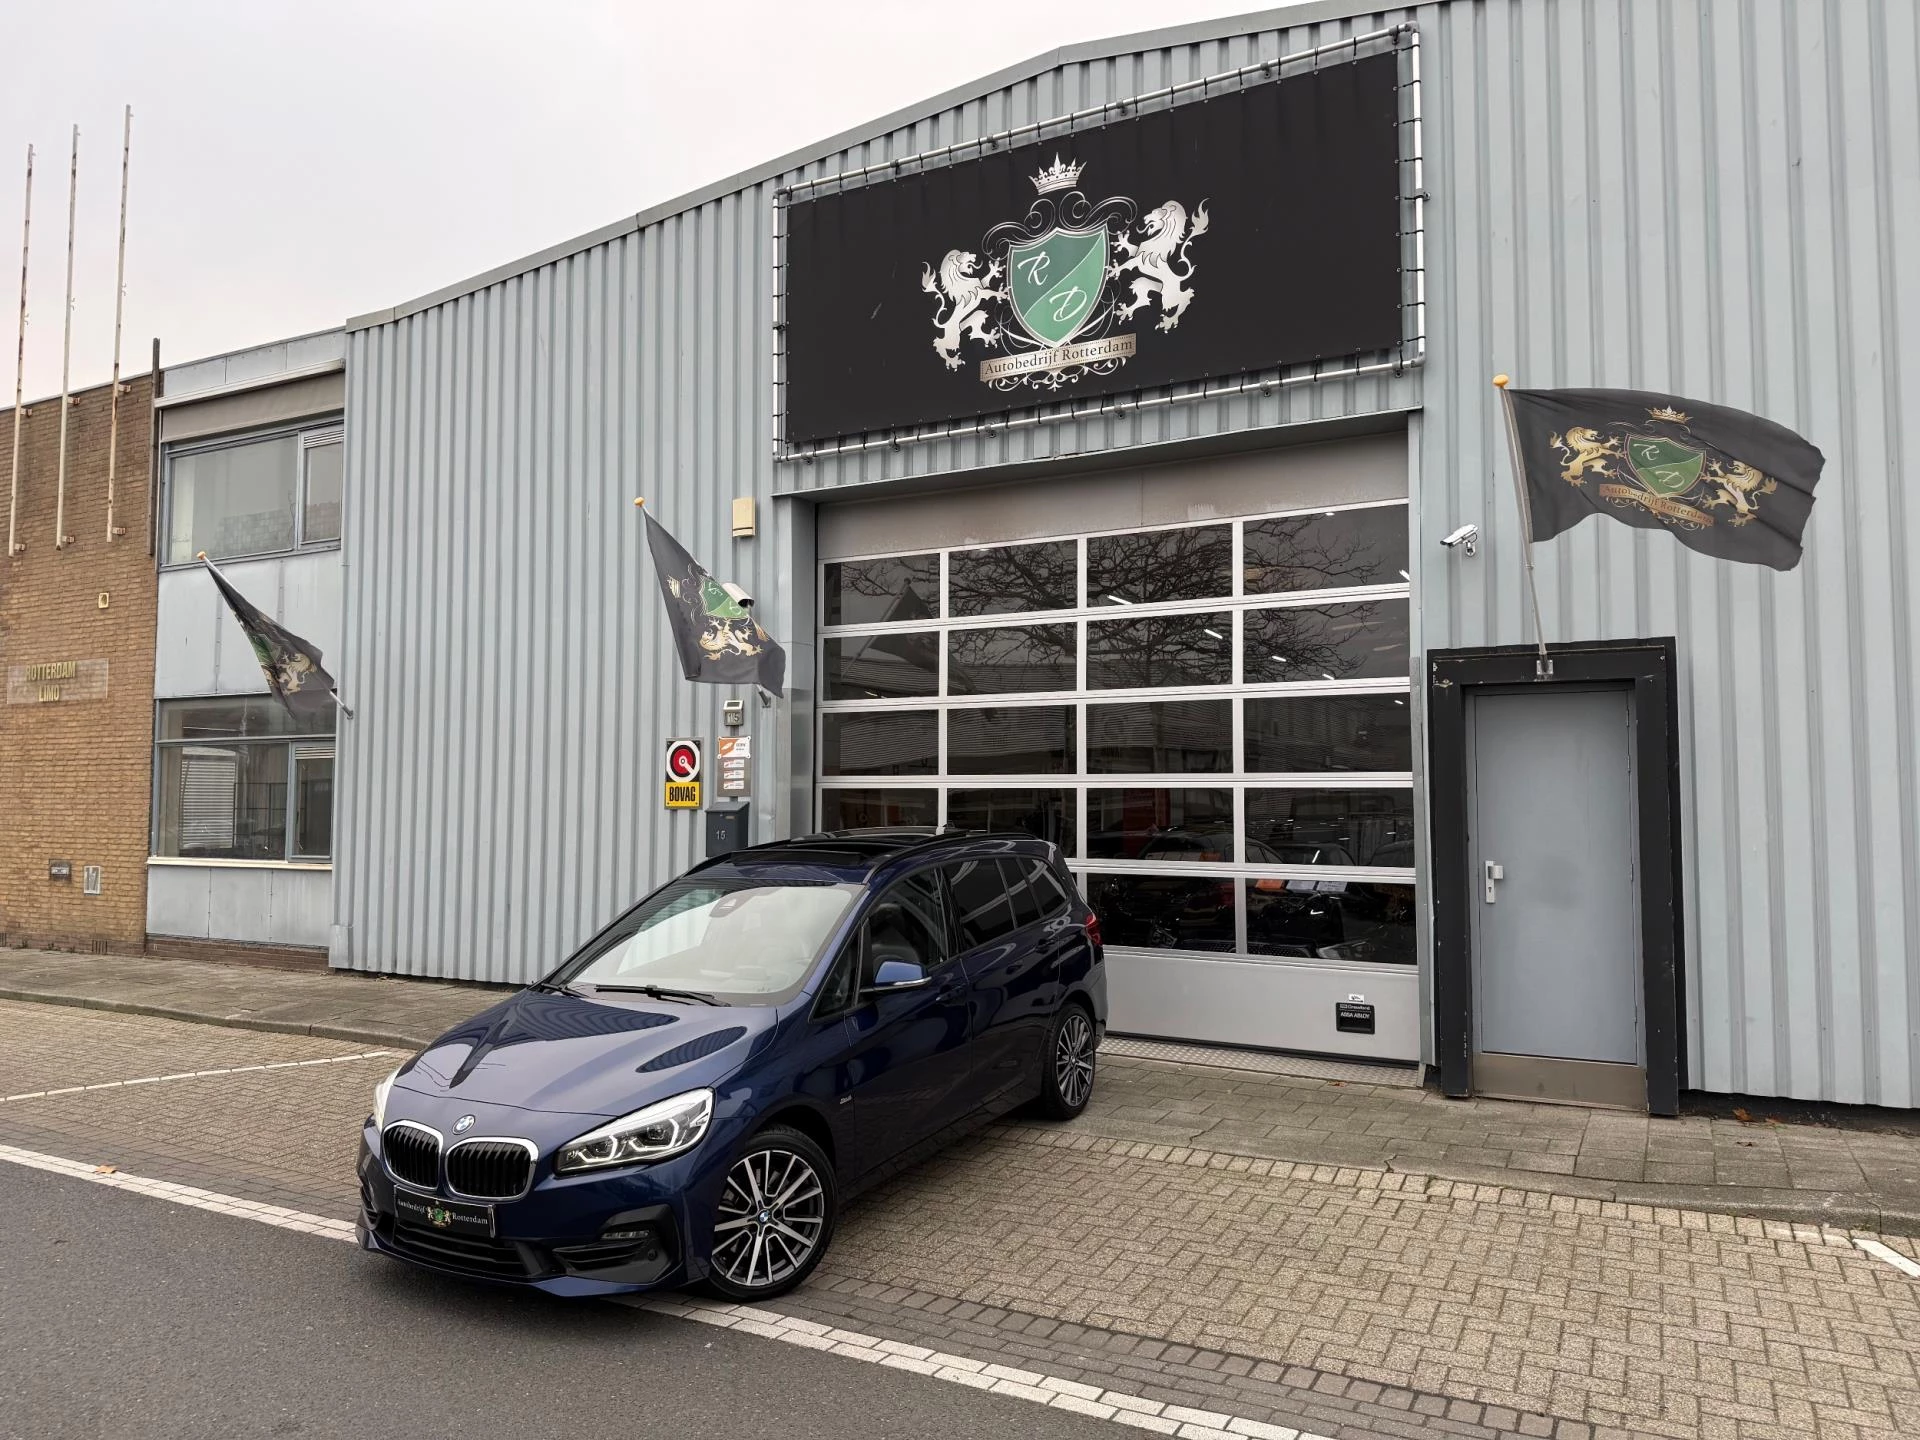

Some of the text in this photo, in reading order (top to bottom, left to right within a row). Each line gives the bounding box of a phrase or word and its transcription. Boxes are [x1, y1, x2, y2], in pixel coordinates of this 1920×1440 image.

[1017, 251, 1050, 286] R
[985, 340, 1132, 374] Autobedrijf Rotterdam
[25, 661, 76, 681] ROTTERDAM
[39, 684, 60, 702] LIMO
[669, 786, 696, 802] BOVAG
[716, 830, 726, 840] 15
[452, 1212, 488, 1224] Rotterdam
